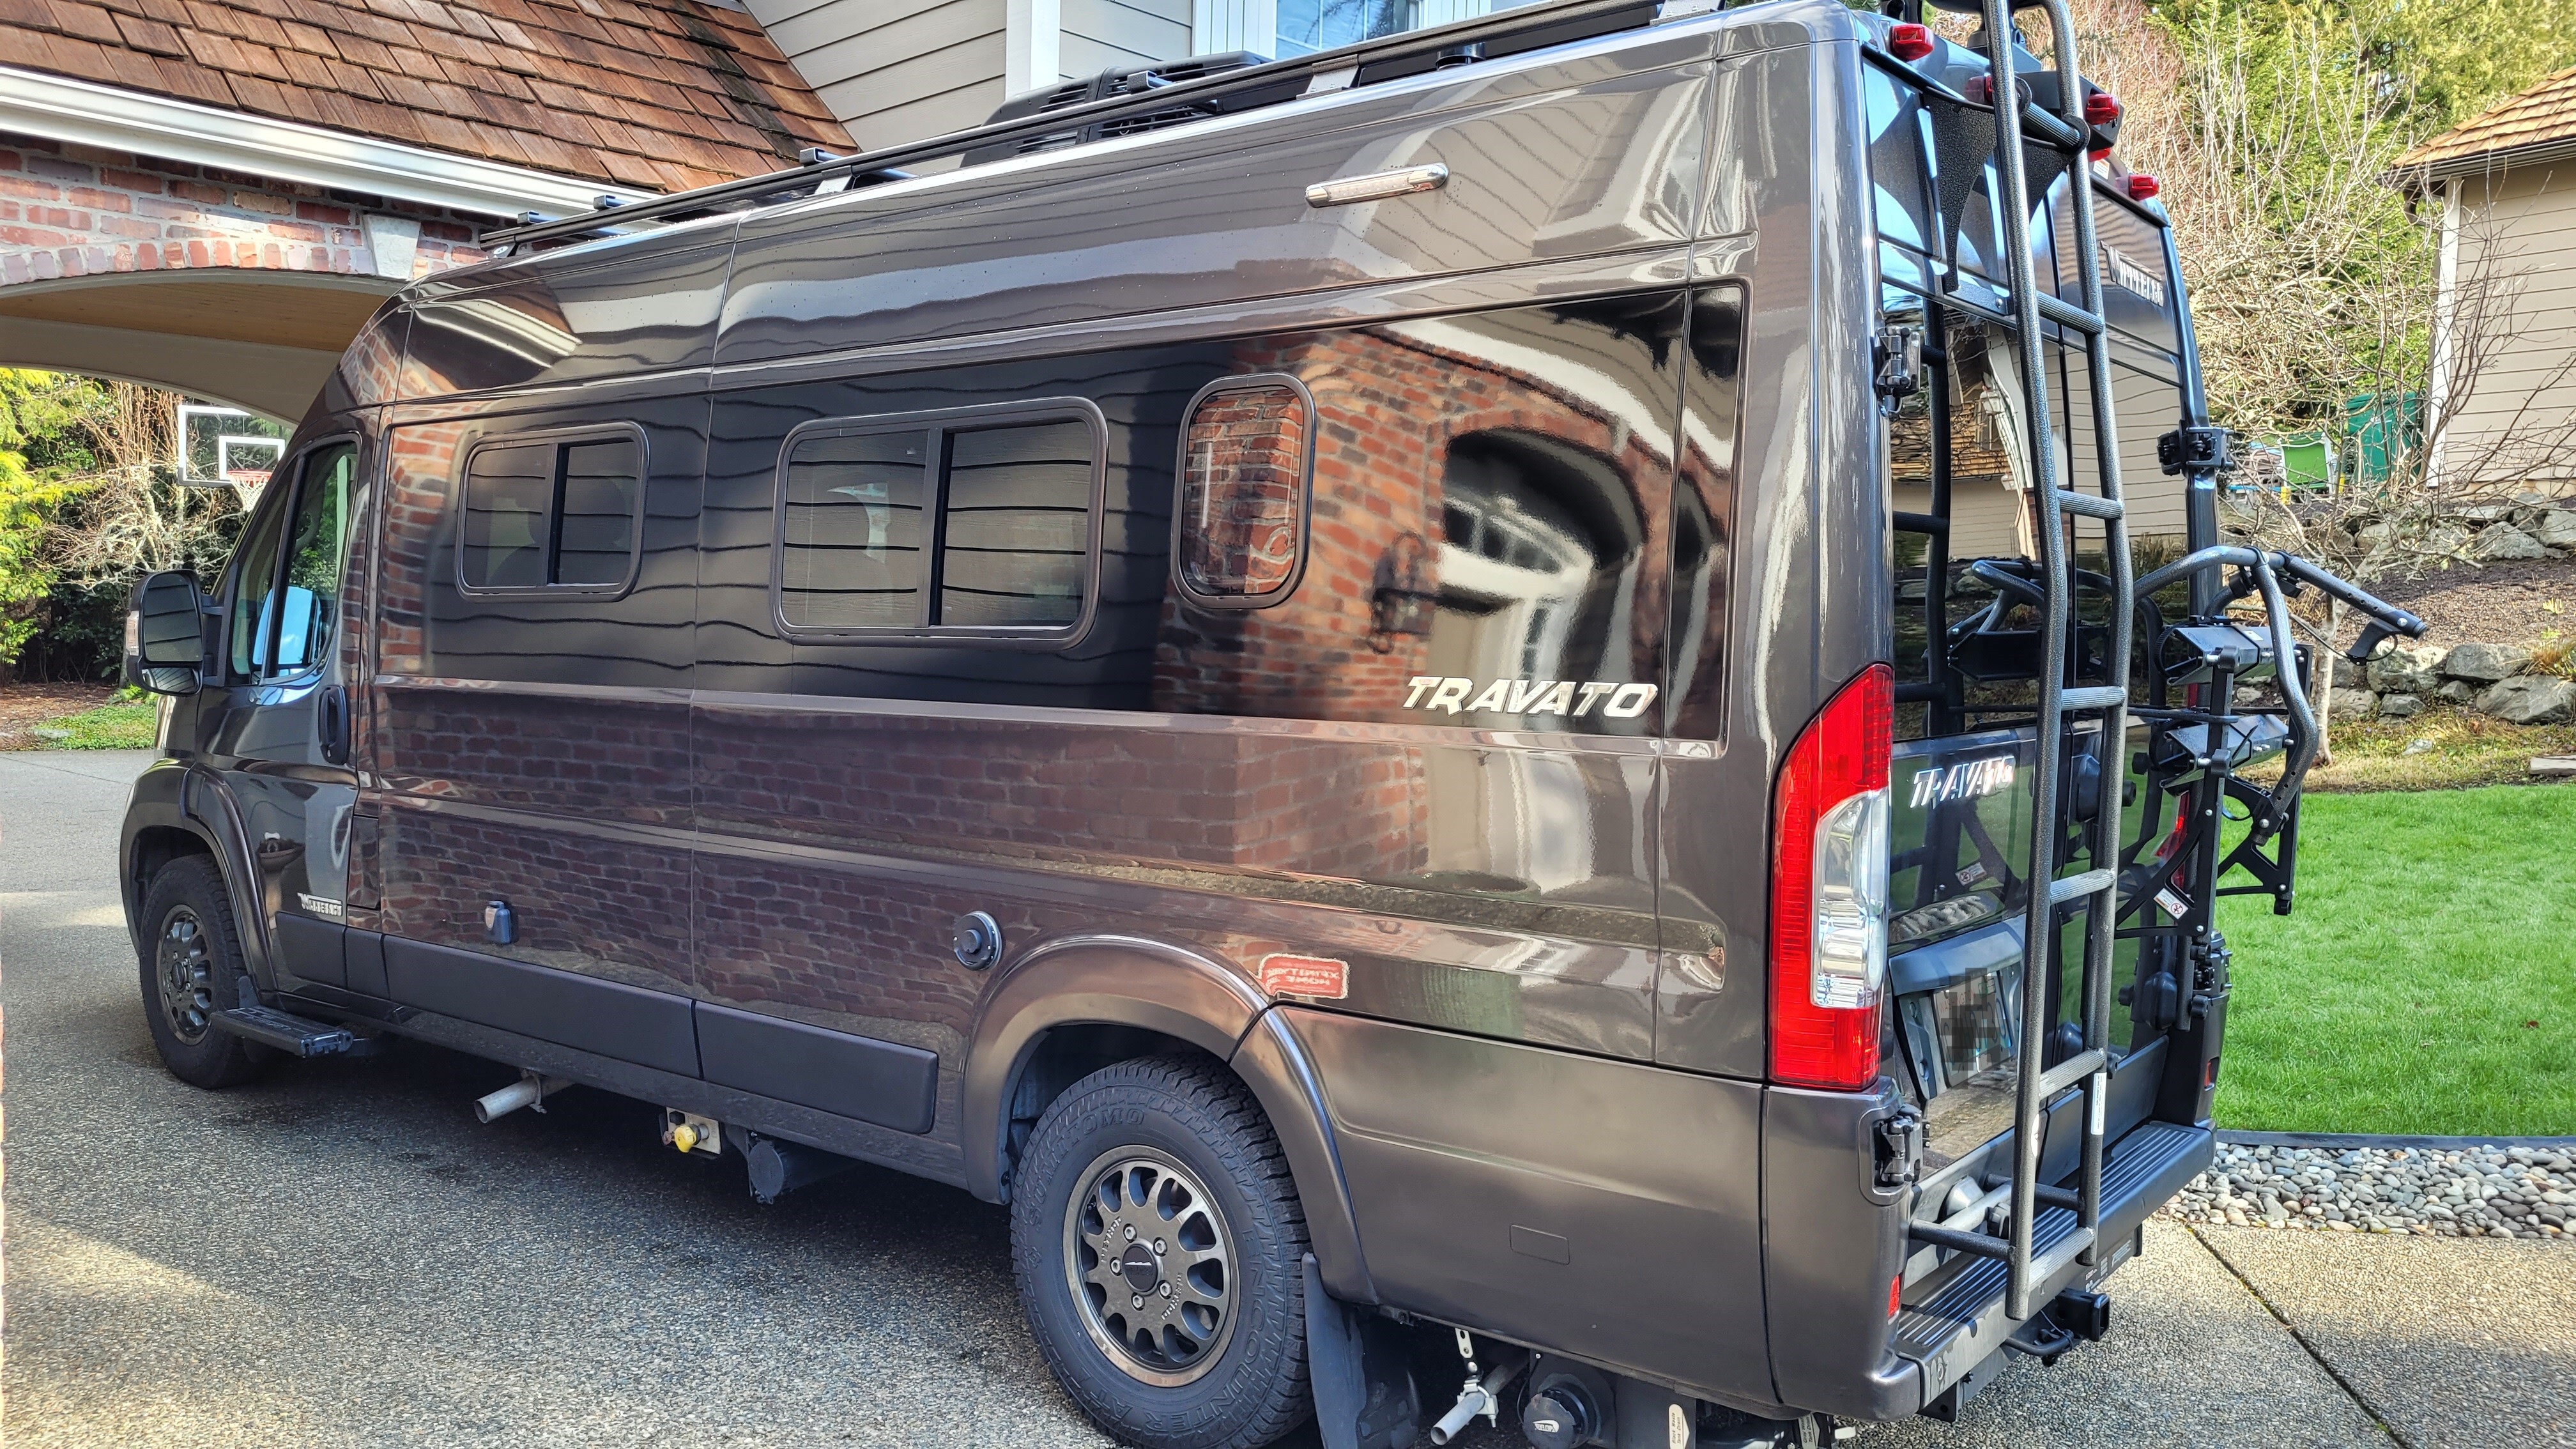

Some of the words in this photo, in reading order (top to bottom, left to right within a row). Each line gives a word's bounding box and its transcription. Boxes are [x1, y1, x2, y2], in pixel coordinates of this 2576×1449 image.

[1402, 676, 1659, 718] TRAVATO
[1029, 1108, 1144, 1232] SUMITOMO
[1144, 1229, 1266, 1433] ENCOUNTER
